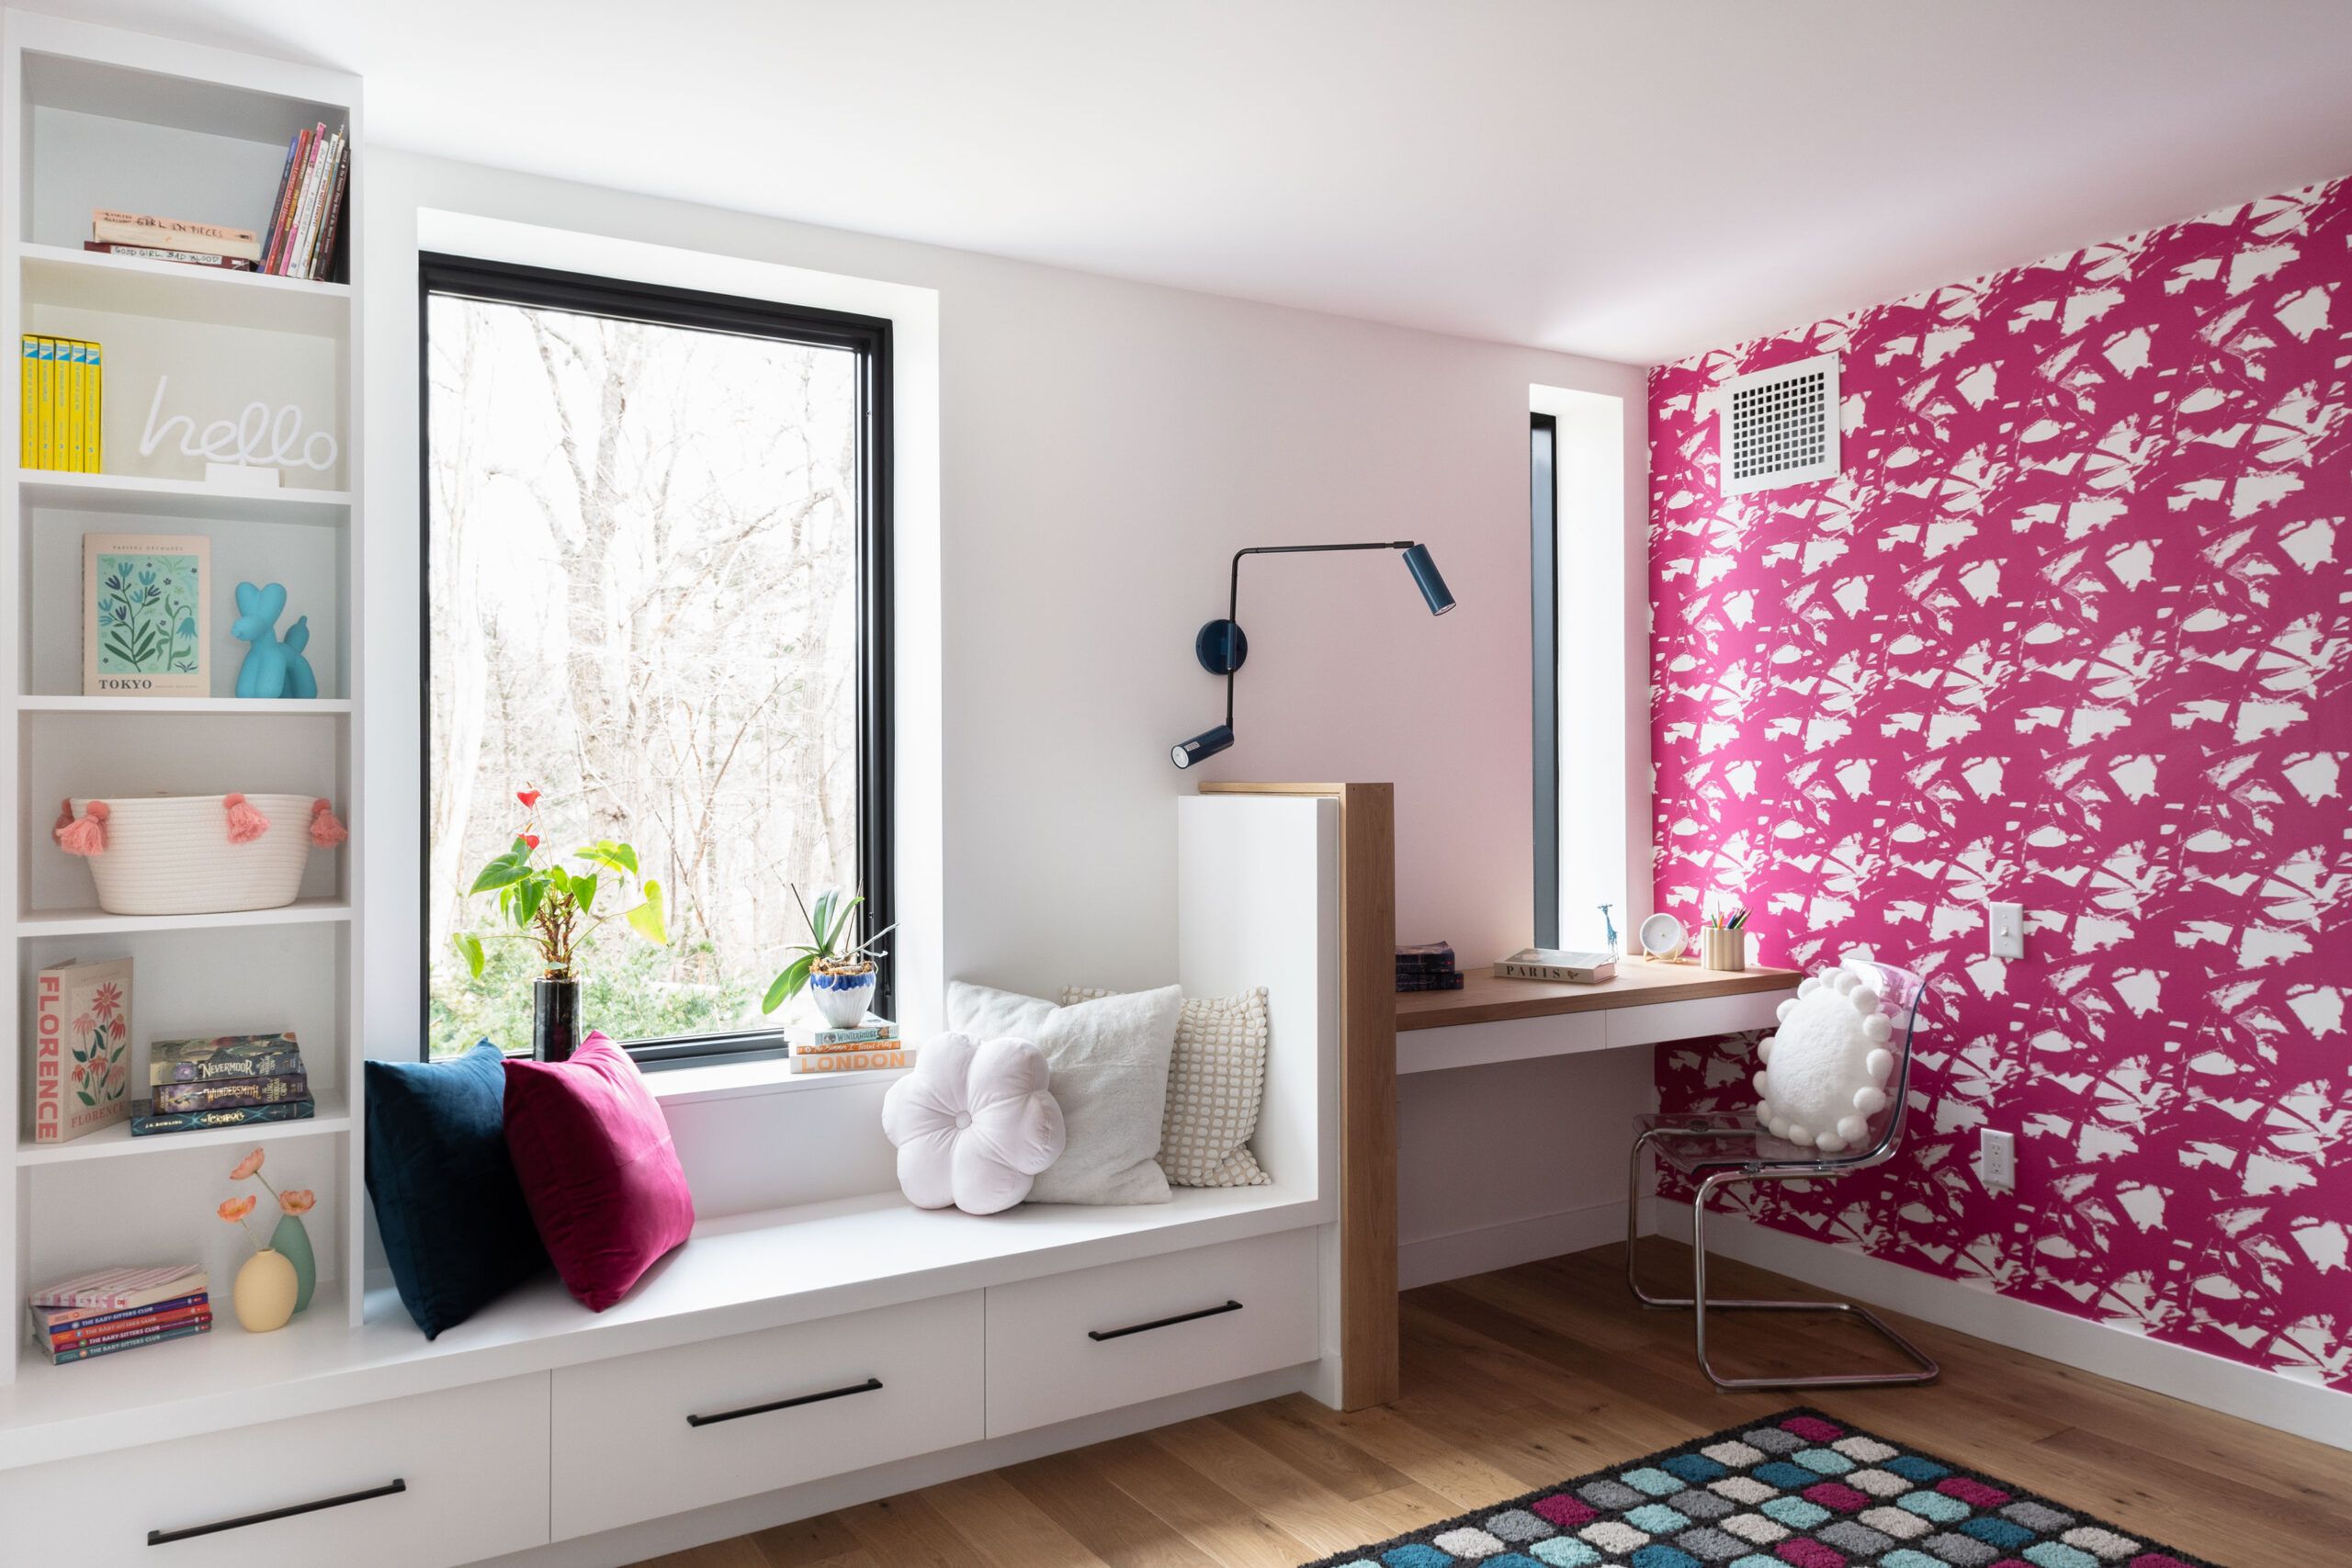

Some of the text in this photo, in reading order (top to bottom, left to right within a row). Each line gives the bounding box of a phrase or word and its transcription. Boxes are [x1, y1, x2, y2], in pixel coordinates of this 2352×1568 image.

[137, 218, 223, 238] GIRL IN PIECES
[115, 246, 137, 256] GOOD
[166, 252, 187, 261] BAD
[189, 254, 220, 264] BLOOD
[139, 375, 339, 471] hello
[98, 679, 153, 689] TOKYO
[1506, 964, 1561, 978] PARIS
[837, 1030, 877, 1042] WINTERHOUSE
[38, 976, 60, 1139] FLORENCE
[801, 1052, 905, 1073] LONDON
[198, 1059, 255, 1078] NEVERMOOR
[204, 1084, 262, 1102] WUNDERSMITH
[71, 1101, 126, 1128] FLORENCE
[206, 1110, 245, 1125] ICKABOG
[95, 1310, 137, 1324] BABY-SITTERS
[137, 1306, 153, 1314] CLUB
[102, 1328, 145, 1342] BABY-SITTERS
[144, 1325, 161, 1333] CLUB
[103, 1337, 144, 1350] BABY-SITTERS
[145, 1335, 161, 1343] CLUB
